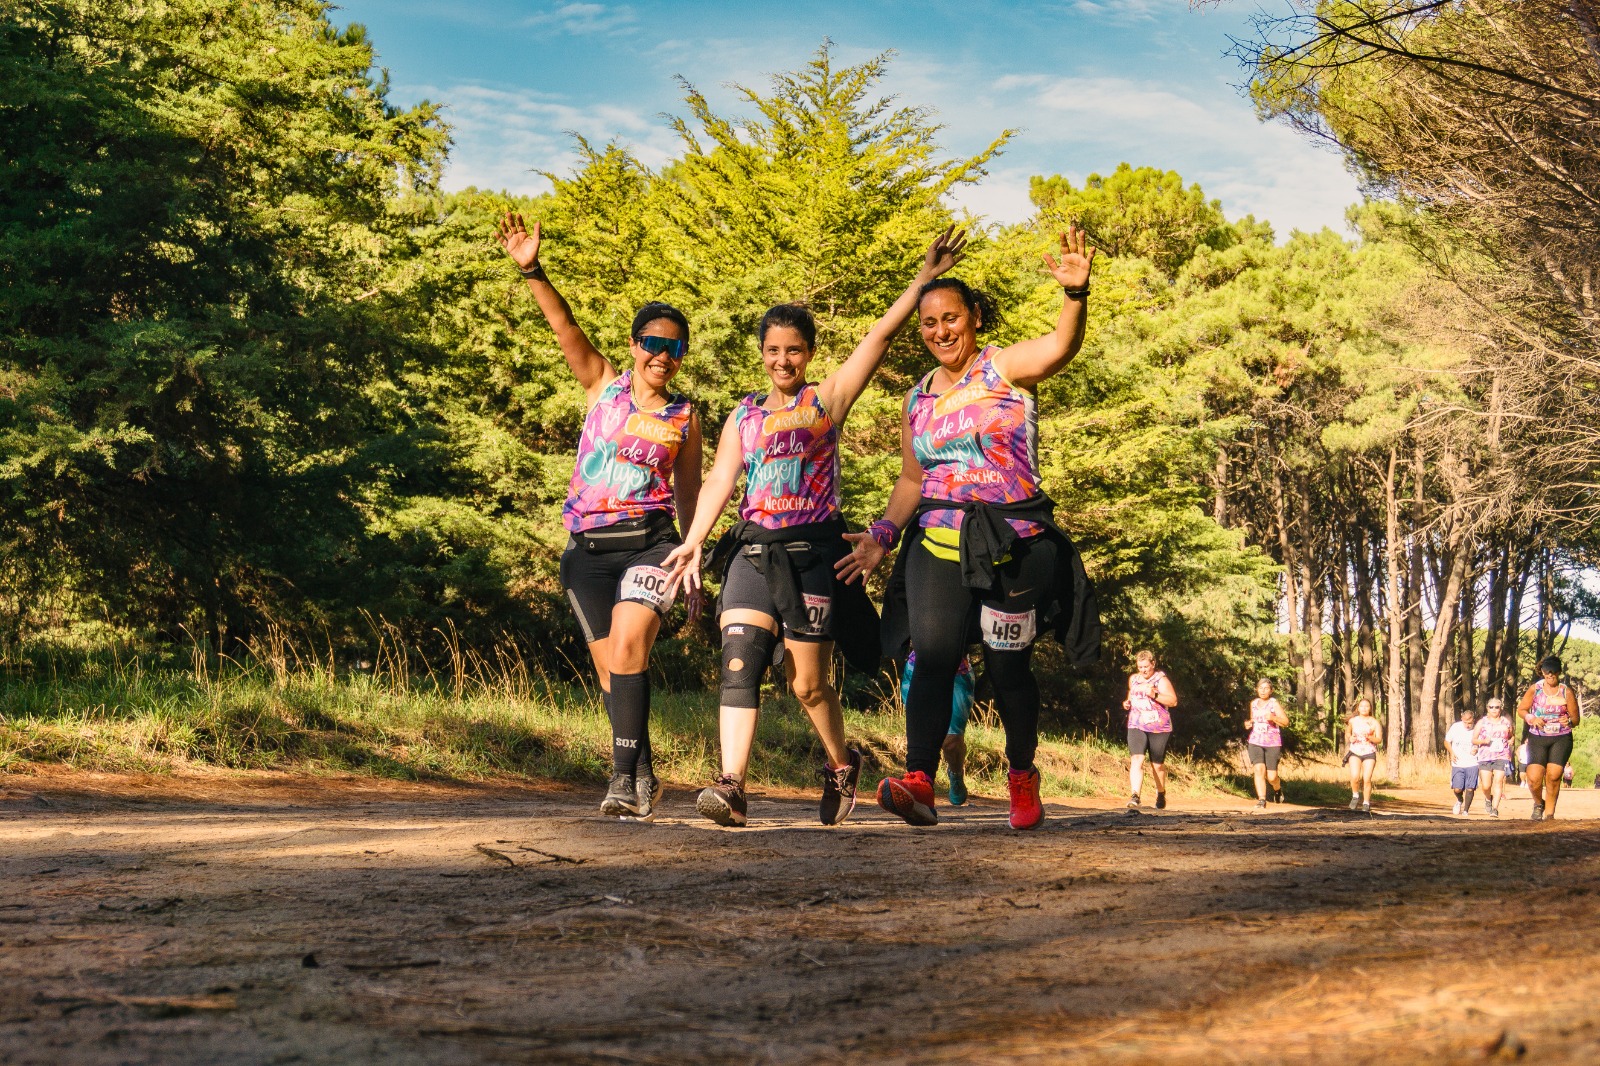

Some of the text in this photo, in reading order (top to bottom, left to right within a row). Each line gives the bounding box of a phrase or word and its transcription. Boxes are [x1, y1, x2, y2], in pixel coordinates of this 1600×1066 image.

[933, 410, 975, 442] de la
[617, 438, 660, 467] de la
[766, 430, 804, 456] de la
[807, 605, 824, 626] 01
[992, 620, 1021, 640] 419
[615, 737, 638, 749] SOX
